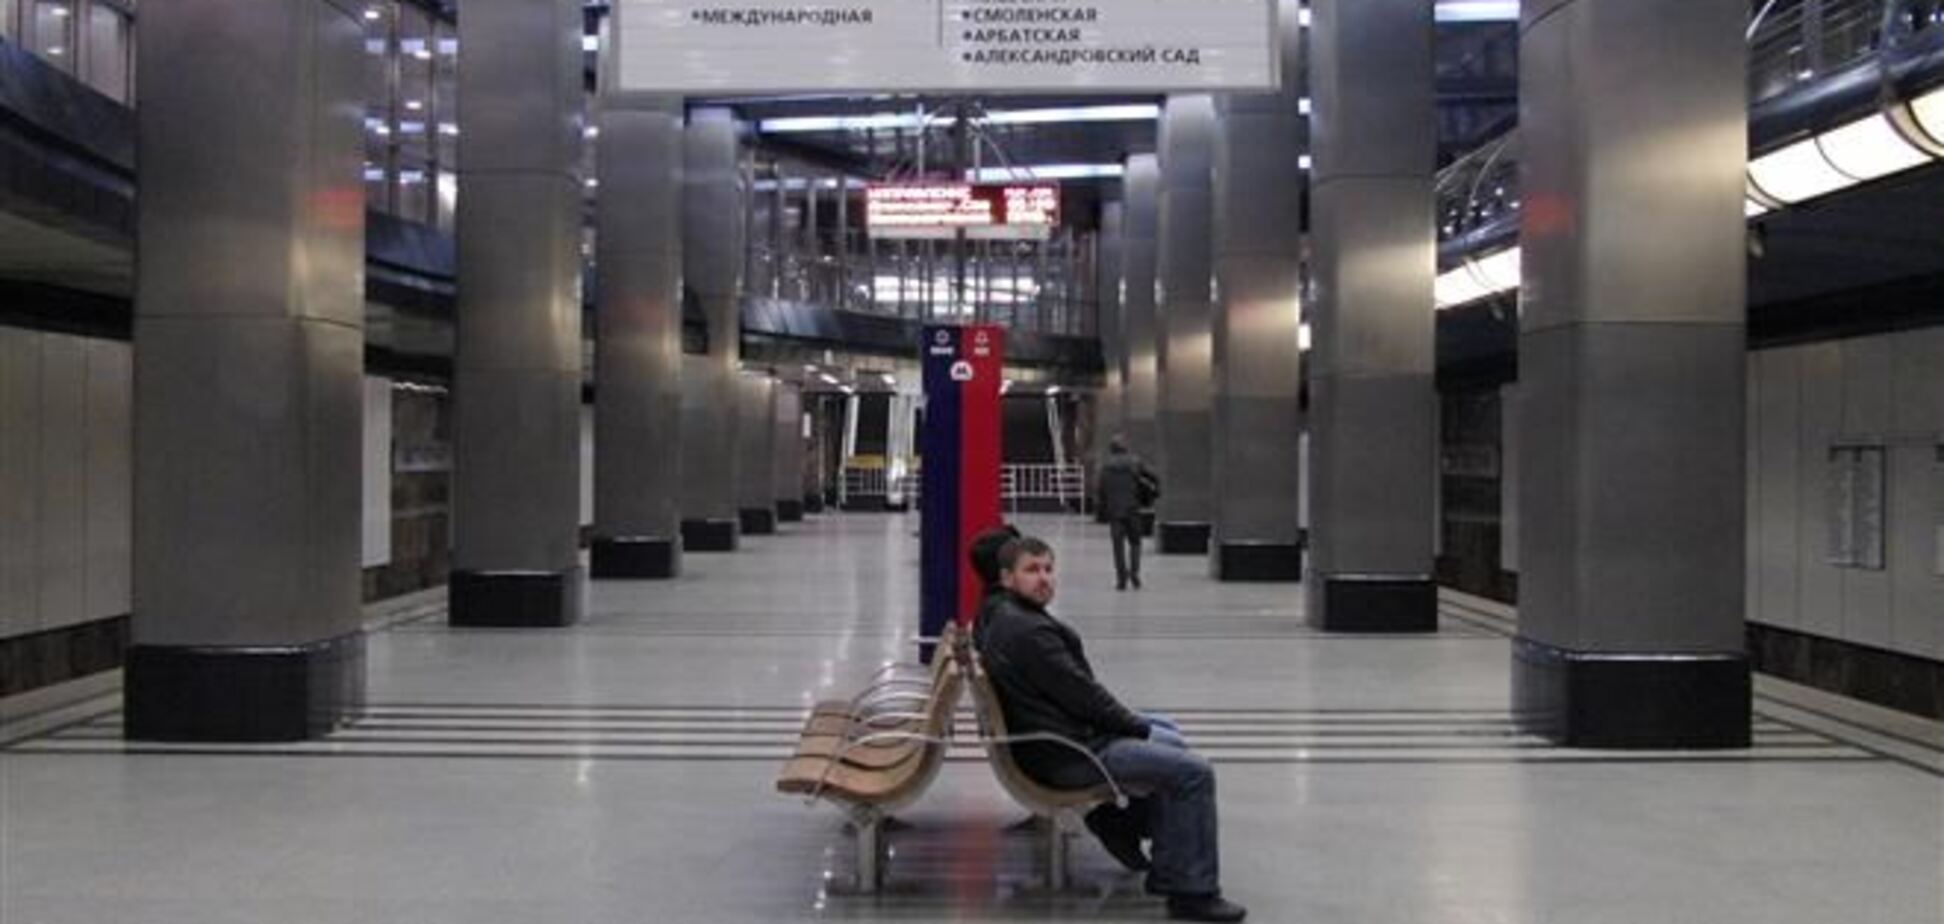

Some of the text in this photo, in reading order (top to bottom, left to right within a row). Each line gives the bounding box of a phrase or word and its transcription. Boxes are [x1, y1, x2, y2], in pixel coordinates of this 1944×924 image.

[702, 8, 873, 25] МЕЖДУНАРОДНАЯ
[974, 7, 1098, 22] СМОЛЕНСКАЯ
[974, 28, 1082, 42] АРБАТСКАЯ
[974, 46, 1200, 64] АЛЕКСАНДРОВСКИЙ САД
